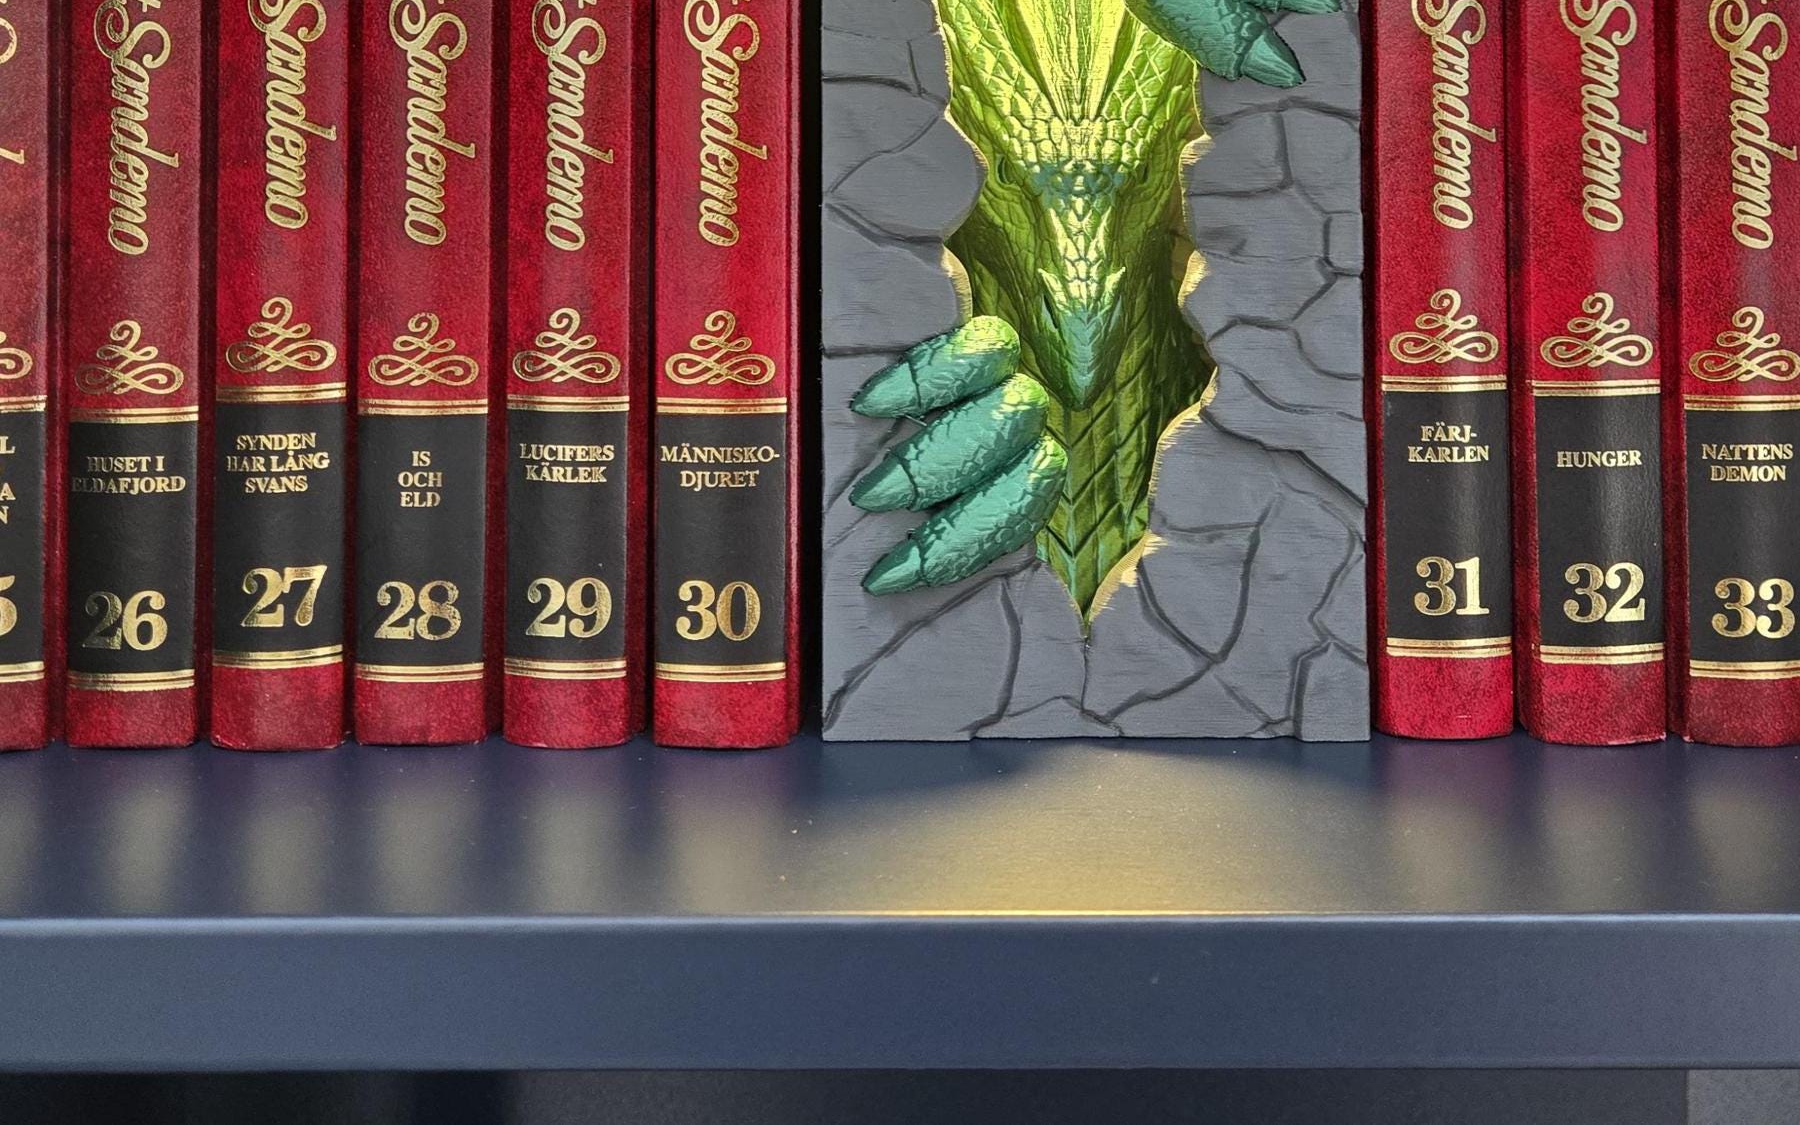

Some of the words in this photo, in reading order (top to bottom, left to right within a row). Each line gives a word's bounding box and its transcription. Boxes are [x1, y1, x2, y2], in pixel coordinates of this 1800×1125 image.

[237, 432, 316, 452] SYNDEN
[1421, 422, 1477, 443] FÄRJ-
[227, 456, 266, 472] HAR
[270, 448, 330, 471] LÅNG
[412, 451, 430, 466] IS
[520, 444, 614, 461] LUCIFERS
[661, 443, 780, 463] MÄNNISKO-
[1408, 445, 1489, 462] KARLEN
[1557, 450, 1642, 467] HUNGER
[1702, 444, 1793, 460] NATTENS
[87, 456, 151, 473] HUSET
[156, 456, 164, 471] I
[526, 462, 607, 483] KÄRLEK
[1711, 465, 1786, 482] DEMON
[246, 475, 308, 493] SVANS
[398, 472, 442, 487] OCH
[680, 470, 759, 491] DJURET
[400, 492, 440, 507] ELD
[241, 564, 327, 627] 27
[1415, 557, 1489, 615] 31
[1564, 562, 1645, 622] 32
[375, 581, 461, 640] 28
[526, 578, 612, 638] 29
[676, 580, 760, 641] 30
[1712, 578, 1795, 638] 33
[82, 590, 168, 651] 26
